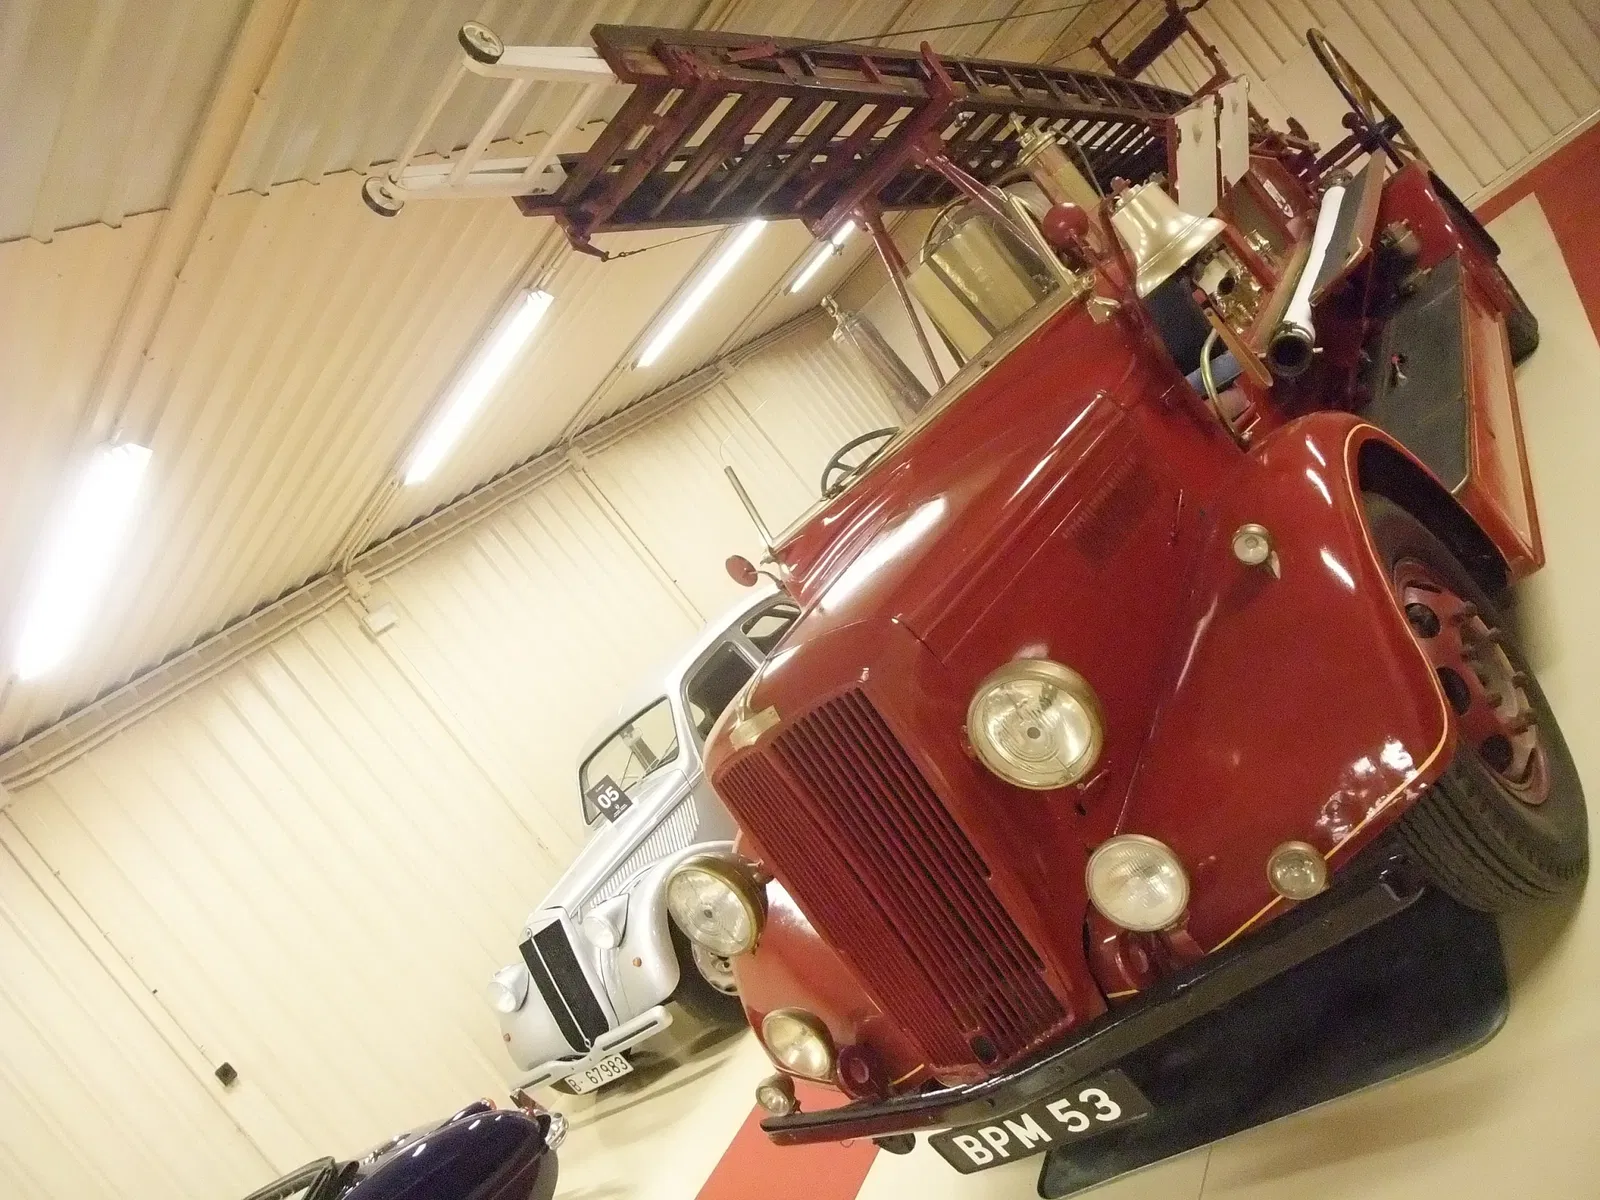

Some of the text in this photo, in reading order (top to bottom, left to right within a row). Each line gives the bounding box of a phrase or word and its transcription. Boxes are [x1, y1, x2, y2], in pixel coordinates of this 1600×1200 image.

[597, 785, 620, 809] 05
[952, 1088, 1121, 1166] BPM 53
